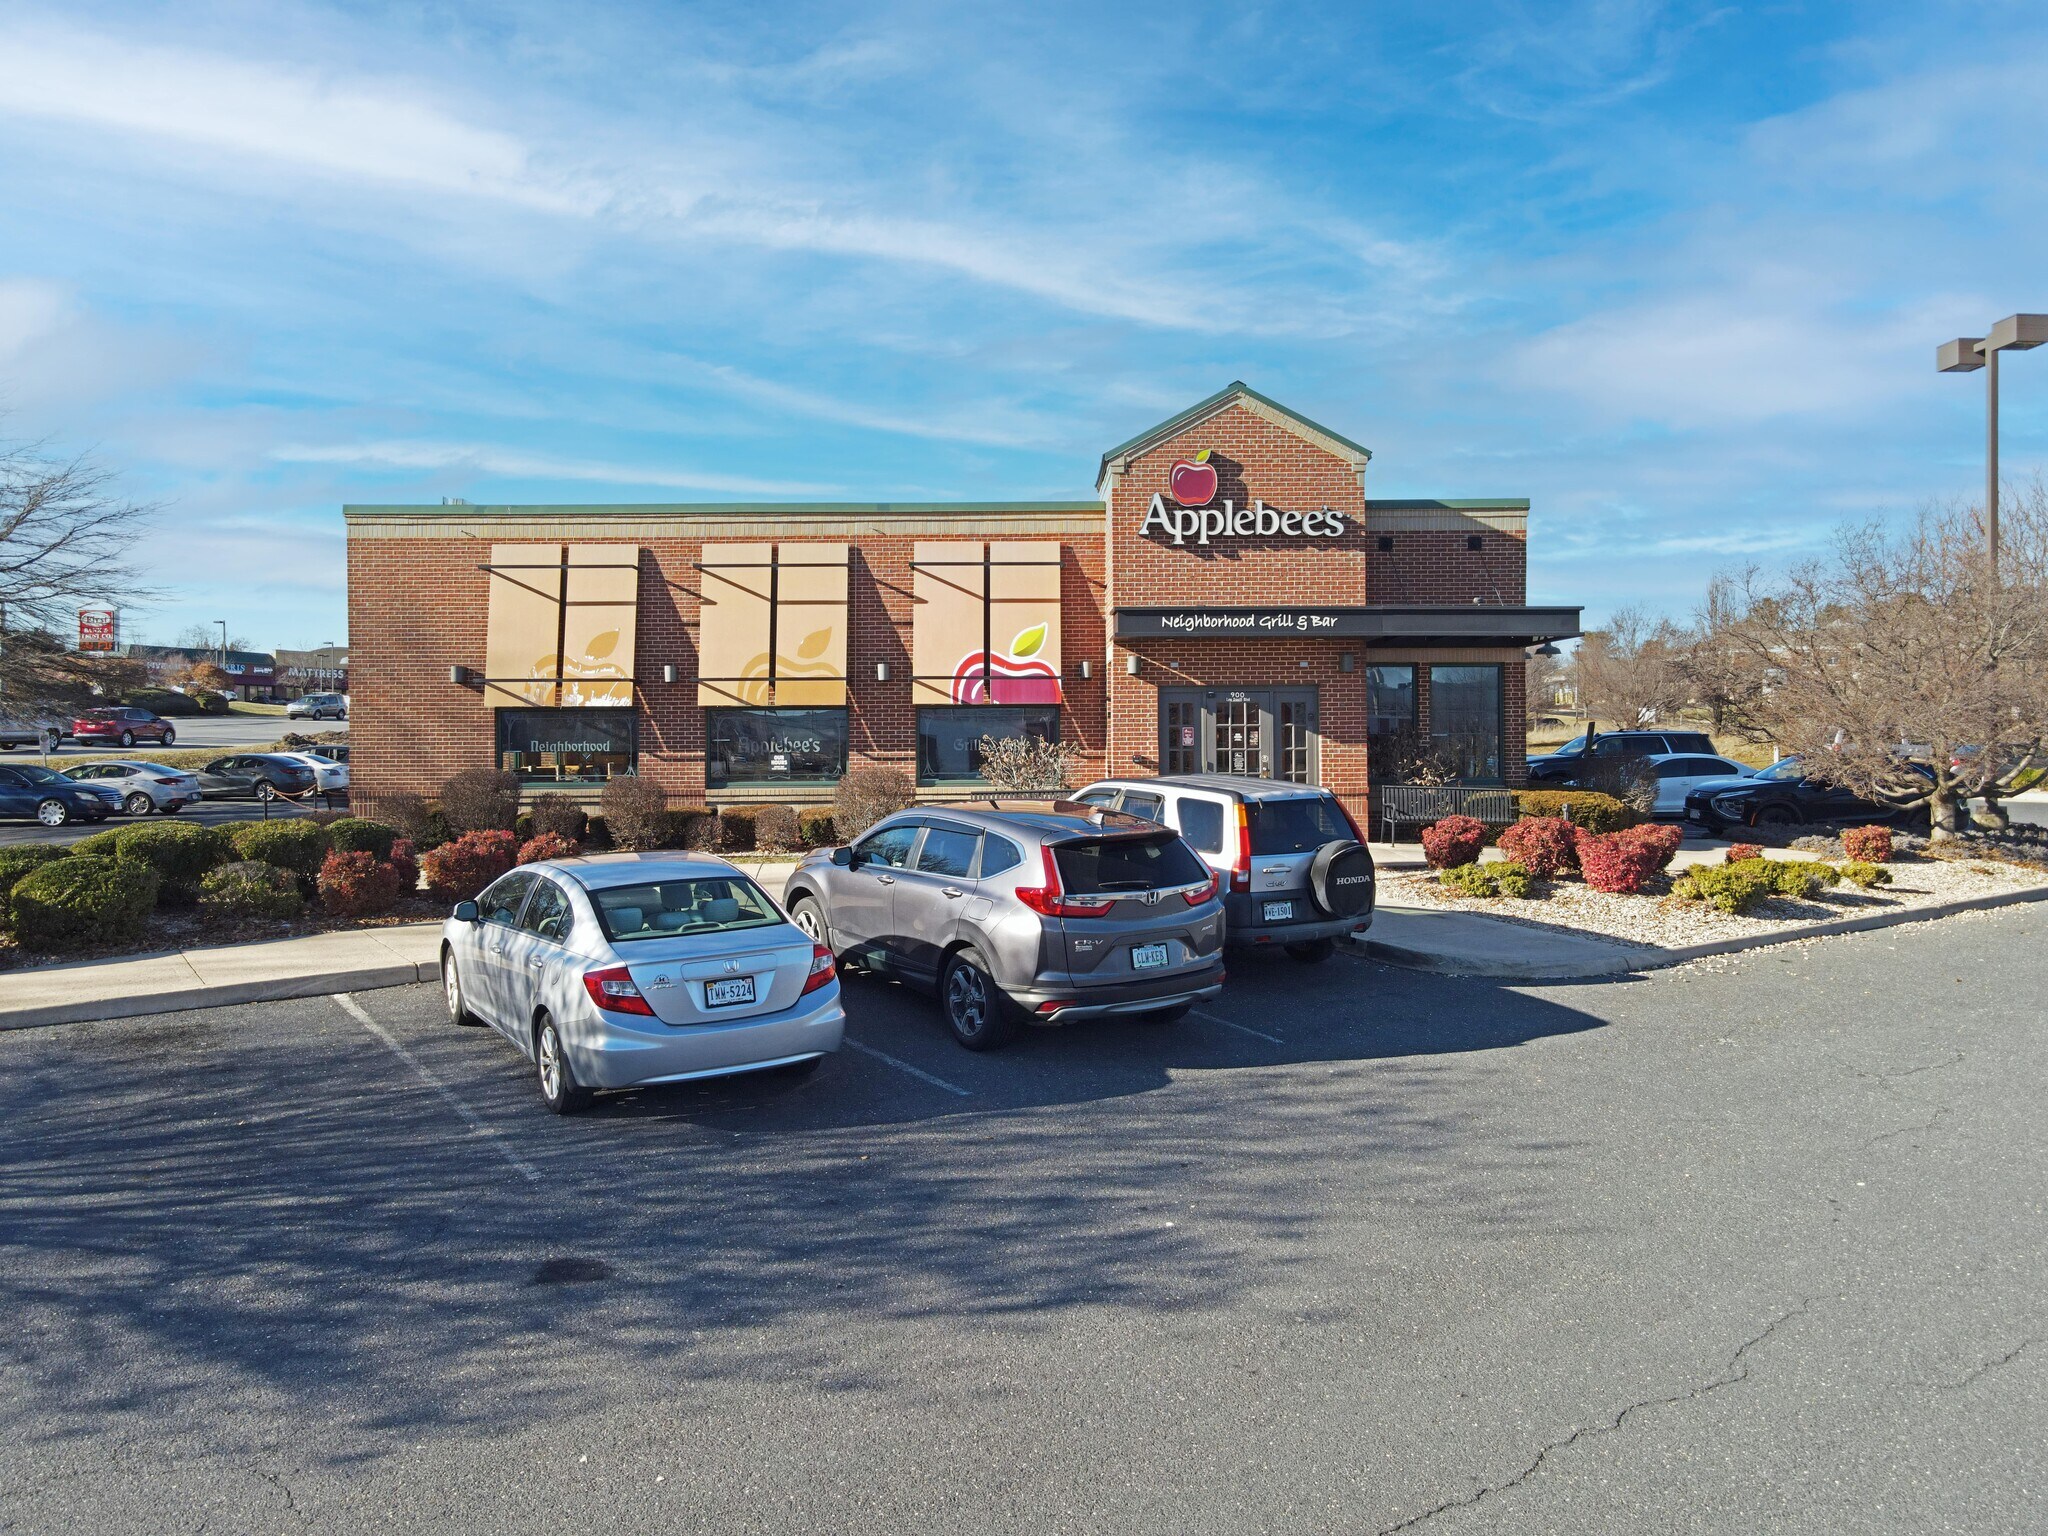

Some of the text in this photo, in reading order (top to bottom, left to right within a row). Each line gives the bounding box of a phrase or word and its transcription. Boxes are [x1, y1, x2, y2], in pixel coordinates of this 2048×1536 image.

[1138, 491, 1345, 545] Applebee's
[1161, 613, 1338, 632] Neighborhood Grill & Bar
[288, 667, 344, 679] MATTRESS
[530, 740, 610, 754] Neighborhood
[1336, 874, 1371, 885] HONDA
